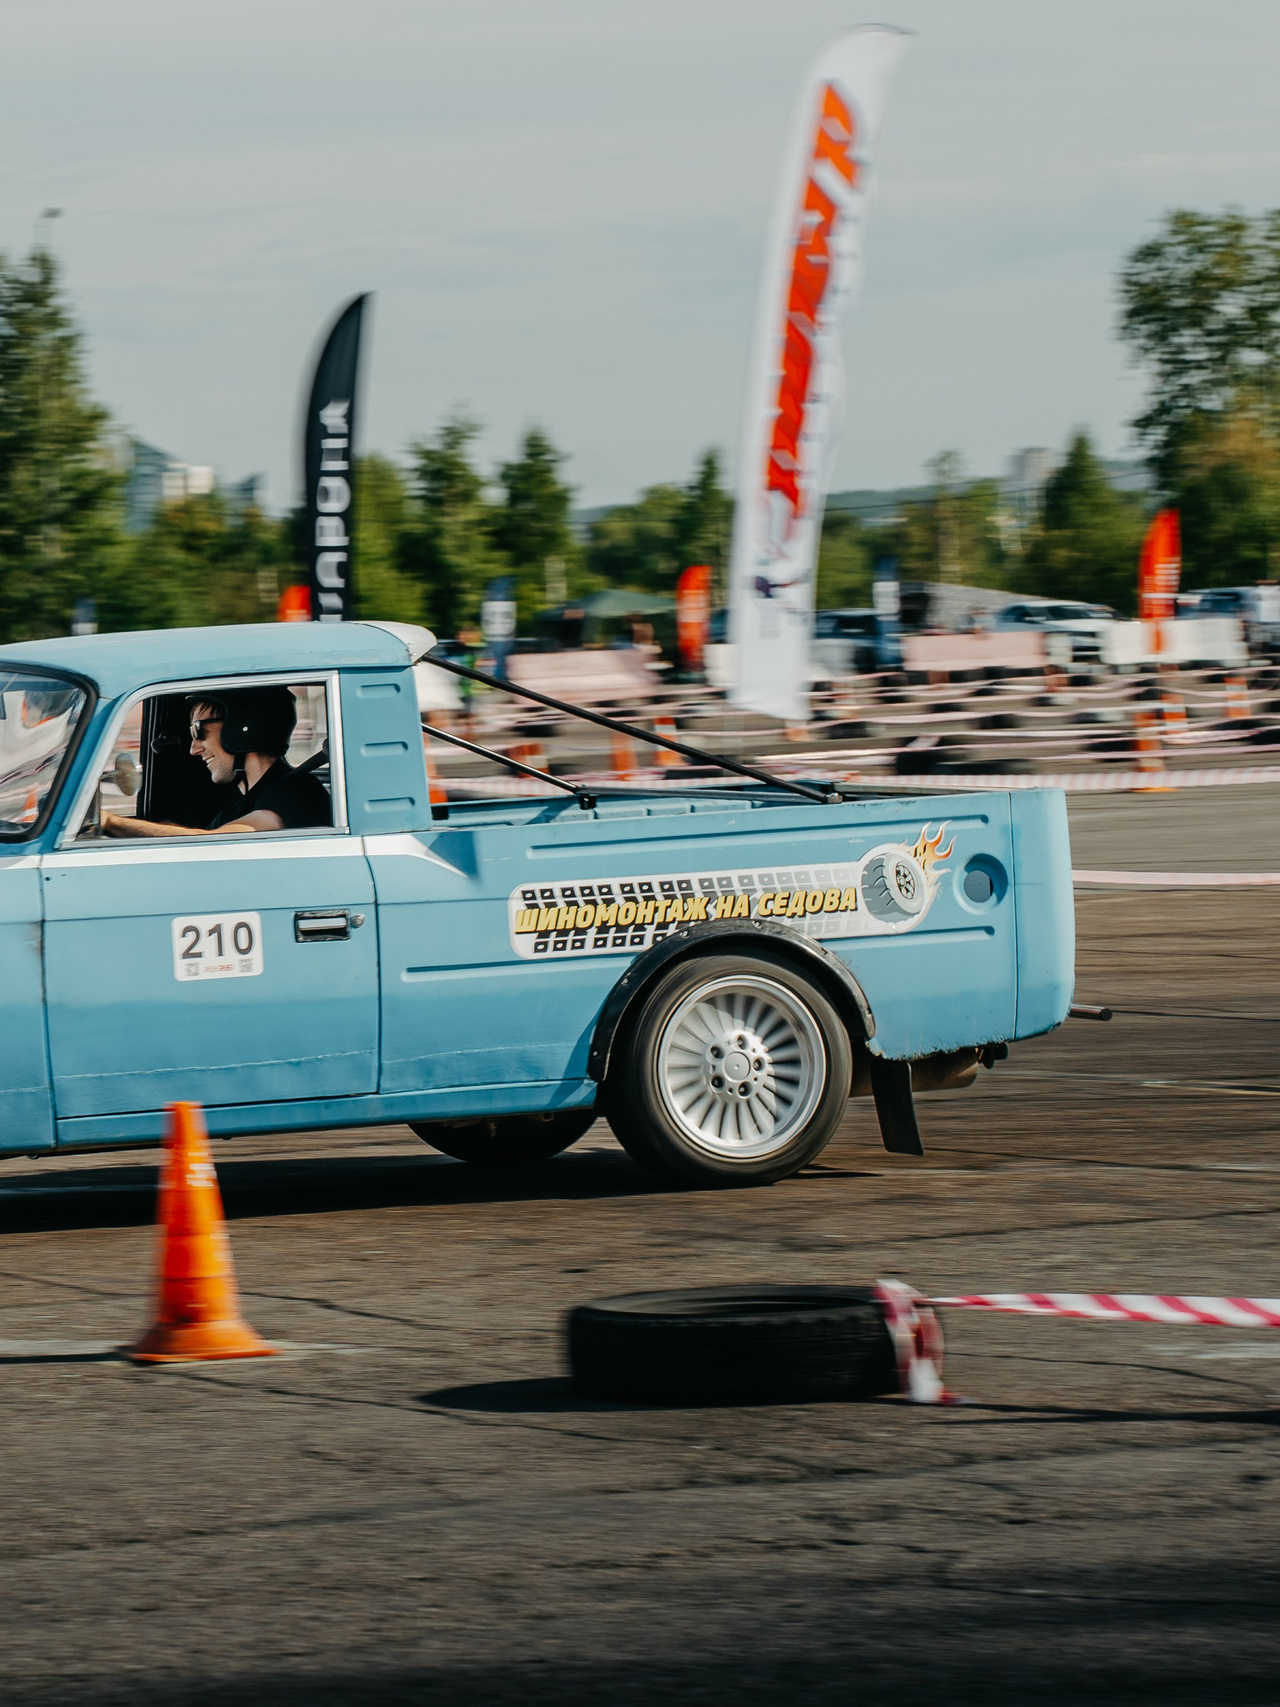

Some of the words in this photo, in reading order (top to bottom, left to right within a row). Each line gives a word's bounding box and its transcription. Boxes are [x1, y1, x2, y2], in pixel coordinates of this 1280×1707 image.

[514, 896, 709, 934] ШИНОМОНТАЖ
[715, 894, 750, 921] НА
[758, 887, 857, 918] СЕДОВА
[181, 921, 253, 959] 210
